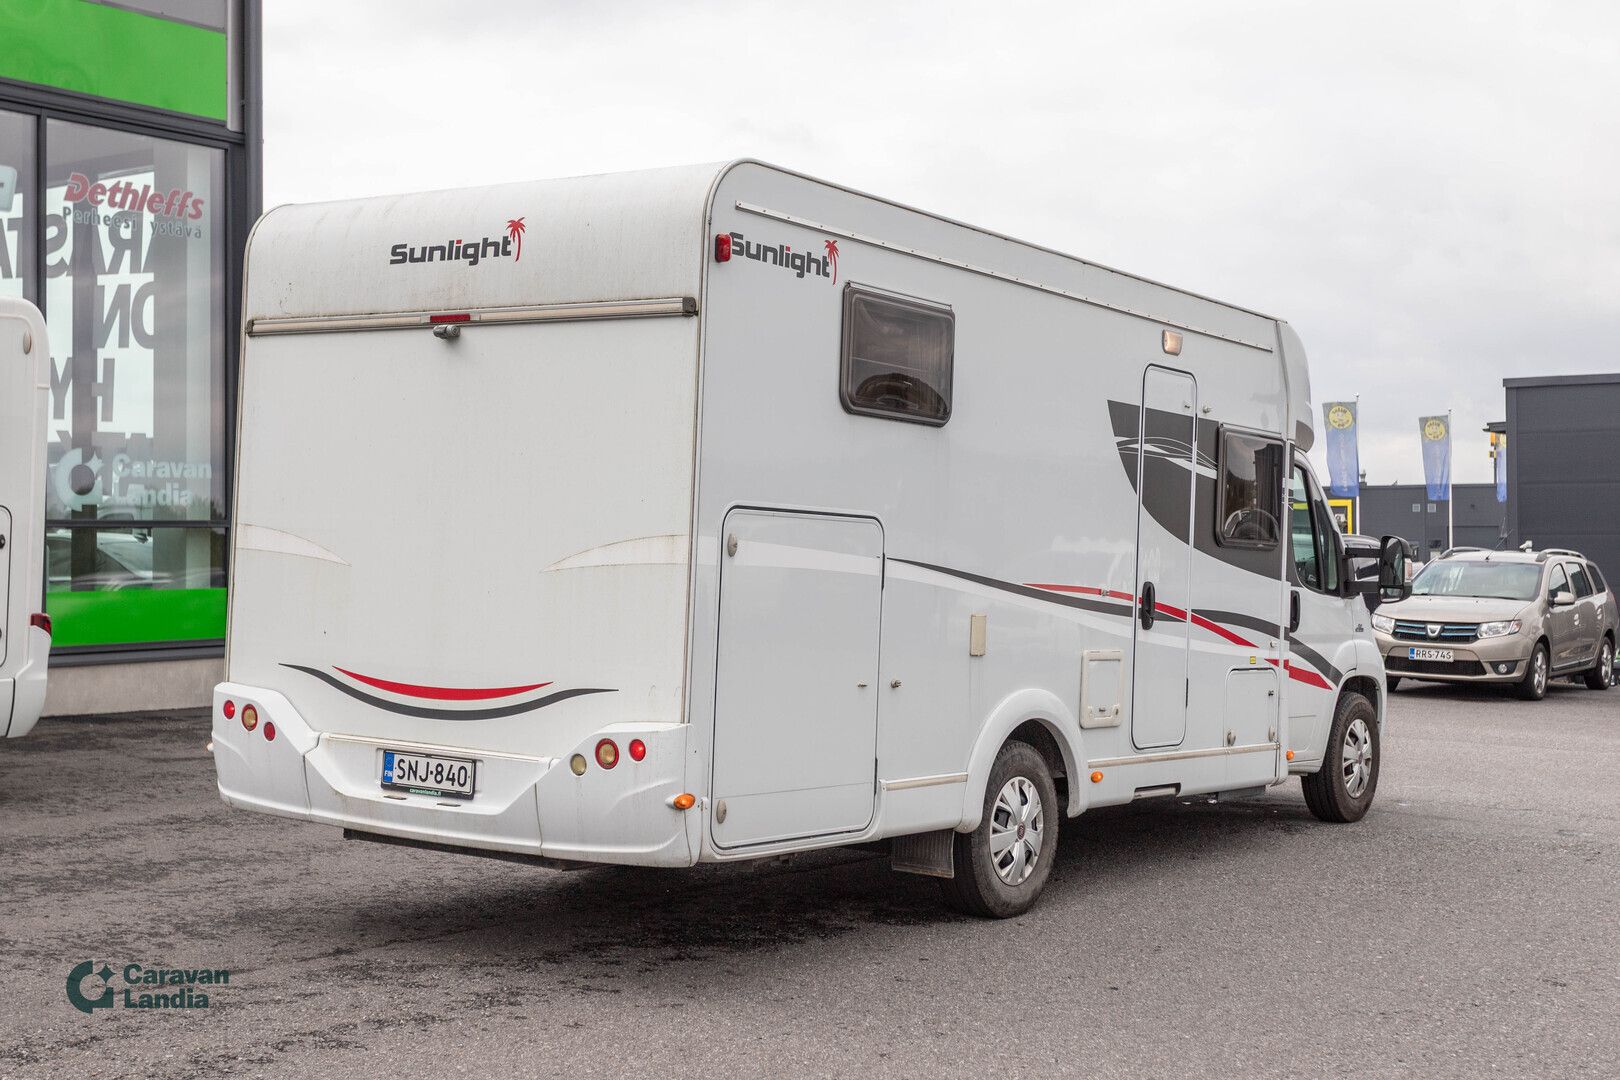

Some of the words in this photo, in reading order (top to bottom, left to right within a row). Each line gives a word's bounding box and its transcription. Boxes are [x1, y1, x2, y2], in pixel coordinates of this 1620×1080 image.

[64, 171, 205, 220] Dethleffs
[63, 205, 137, 232] Perheesi
[150, 219, 202, 240] ystävä
[389, 234, 513, 267] Sunlight
[729, 231, 831, 279] Sunlight
[112, 453, 213, 481] Caravan
[112, 482, 193, 507] Landia
[397, 758, 468, 788] SNJ-840
